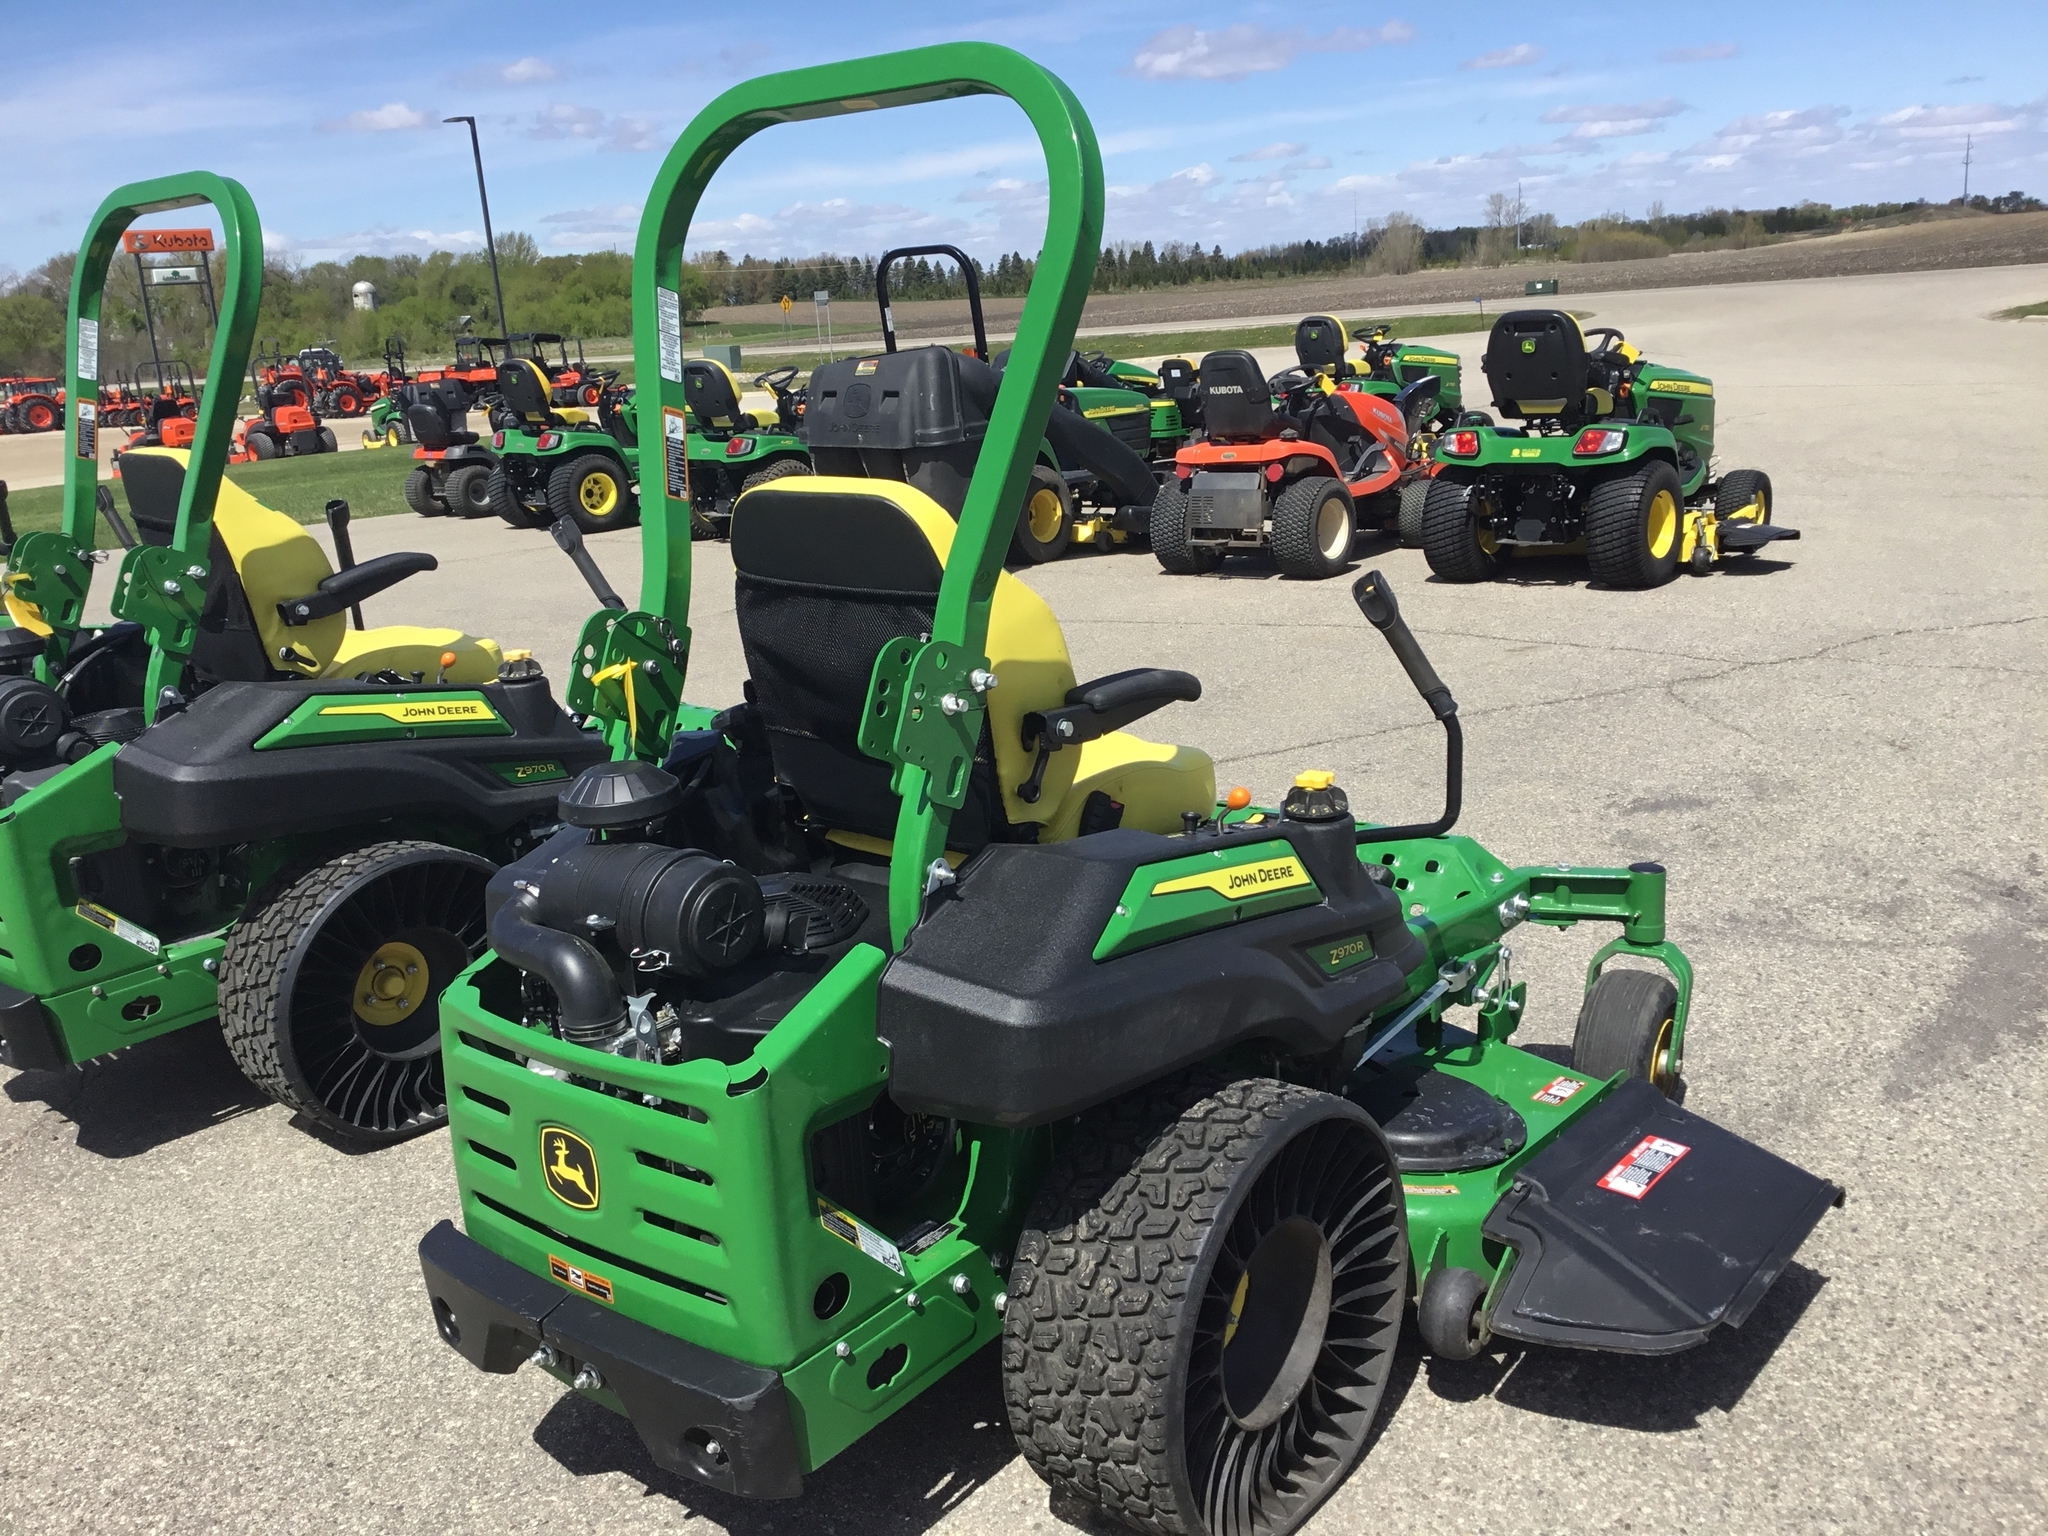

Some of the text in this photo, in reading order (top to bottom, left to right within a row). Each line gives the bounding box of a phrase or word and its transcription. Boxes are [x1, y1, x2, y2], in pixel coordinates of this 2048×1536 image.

[152, 233, 208, 248] Kubota
[1209, 385, 1244, 395] KUBOTA
[1657, 381, 1691, 392] JOHN DEERE
[402, 705, 479, 717] JOHN DEERE
[514, 763, 556, 778] Z970R
[1229, 865, 1295, 889] JOHN DEERE
[1329, 941, 1365, 965] Z970R
